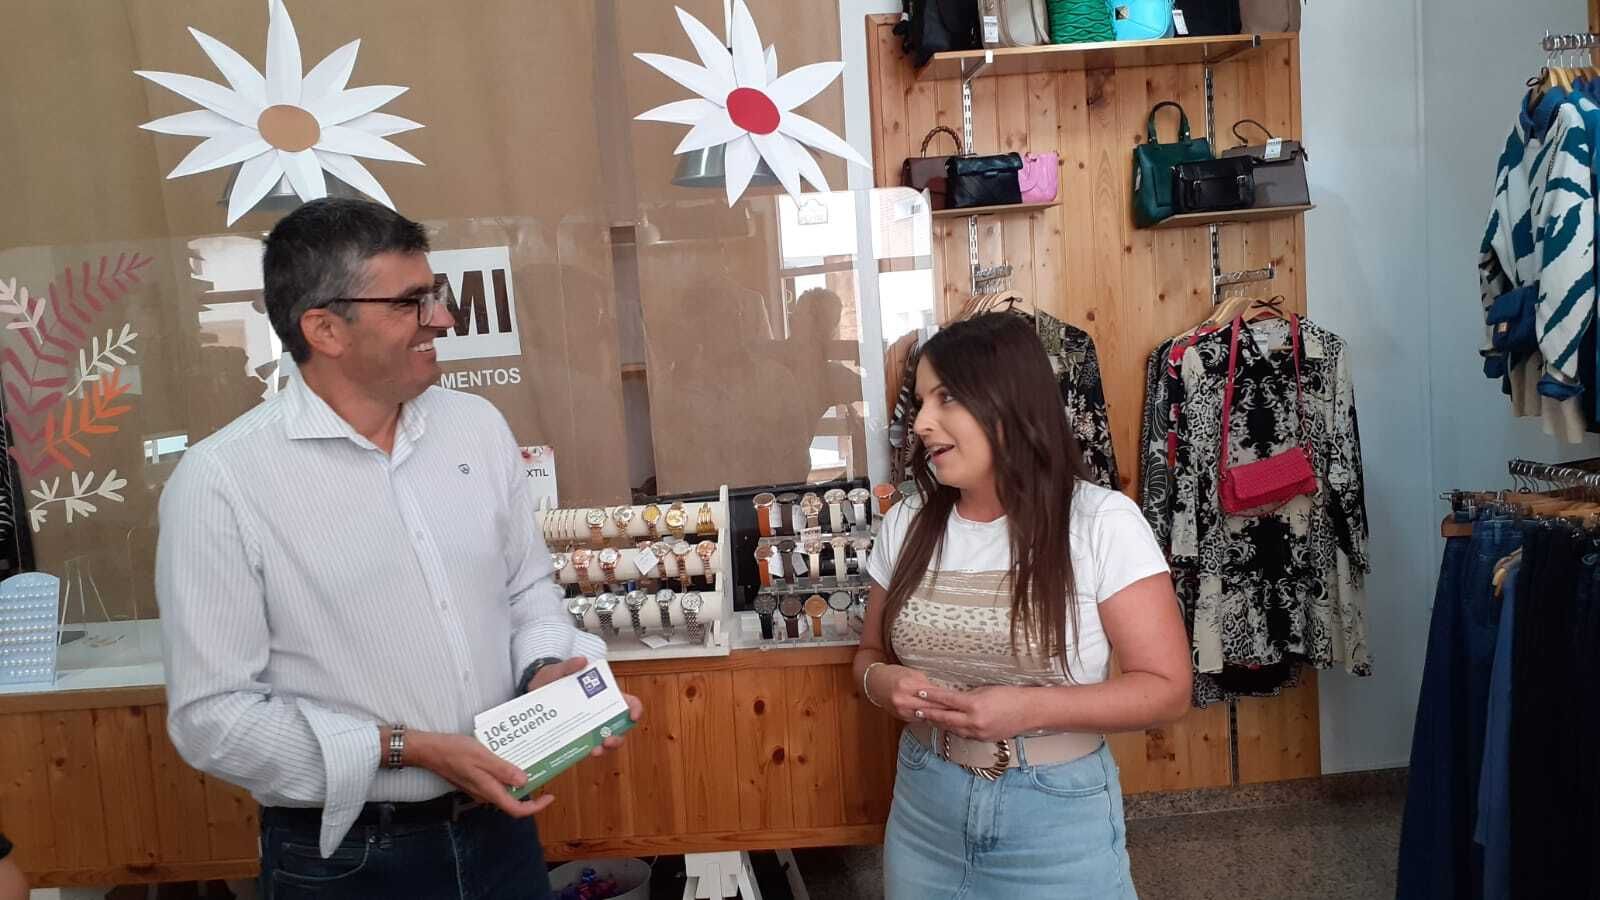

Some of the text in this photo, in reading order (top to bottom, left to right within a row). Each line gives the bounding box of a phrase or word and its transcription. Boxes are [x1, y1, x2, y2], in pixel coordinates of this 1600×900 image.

[484, 703, 544, 741] 10€ Bono
[488, 708, 558, 752] Descuento
